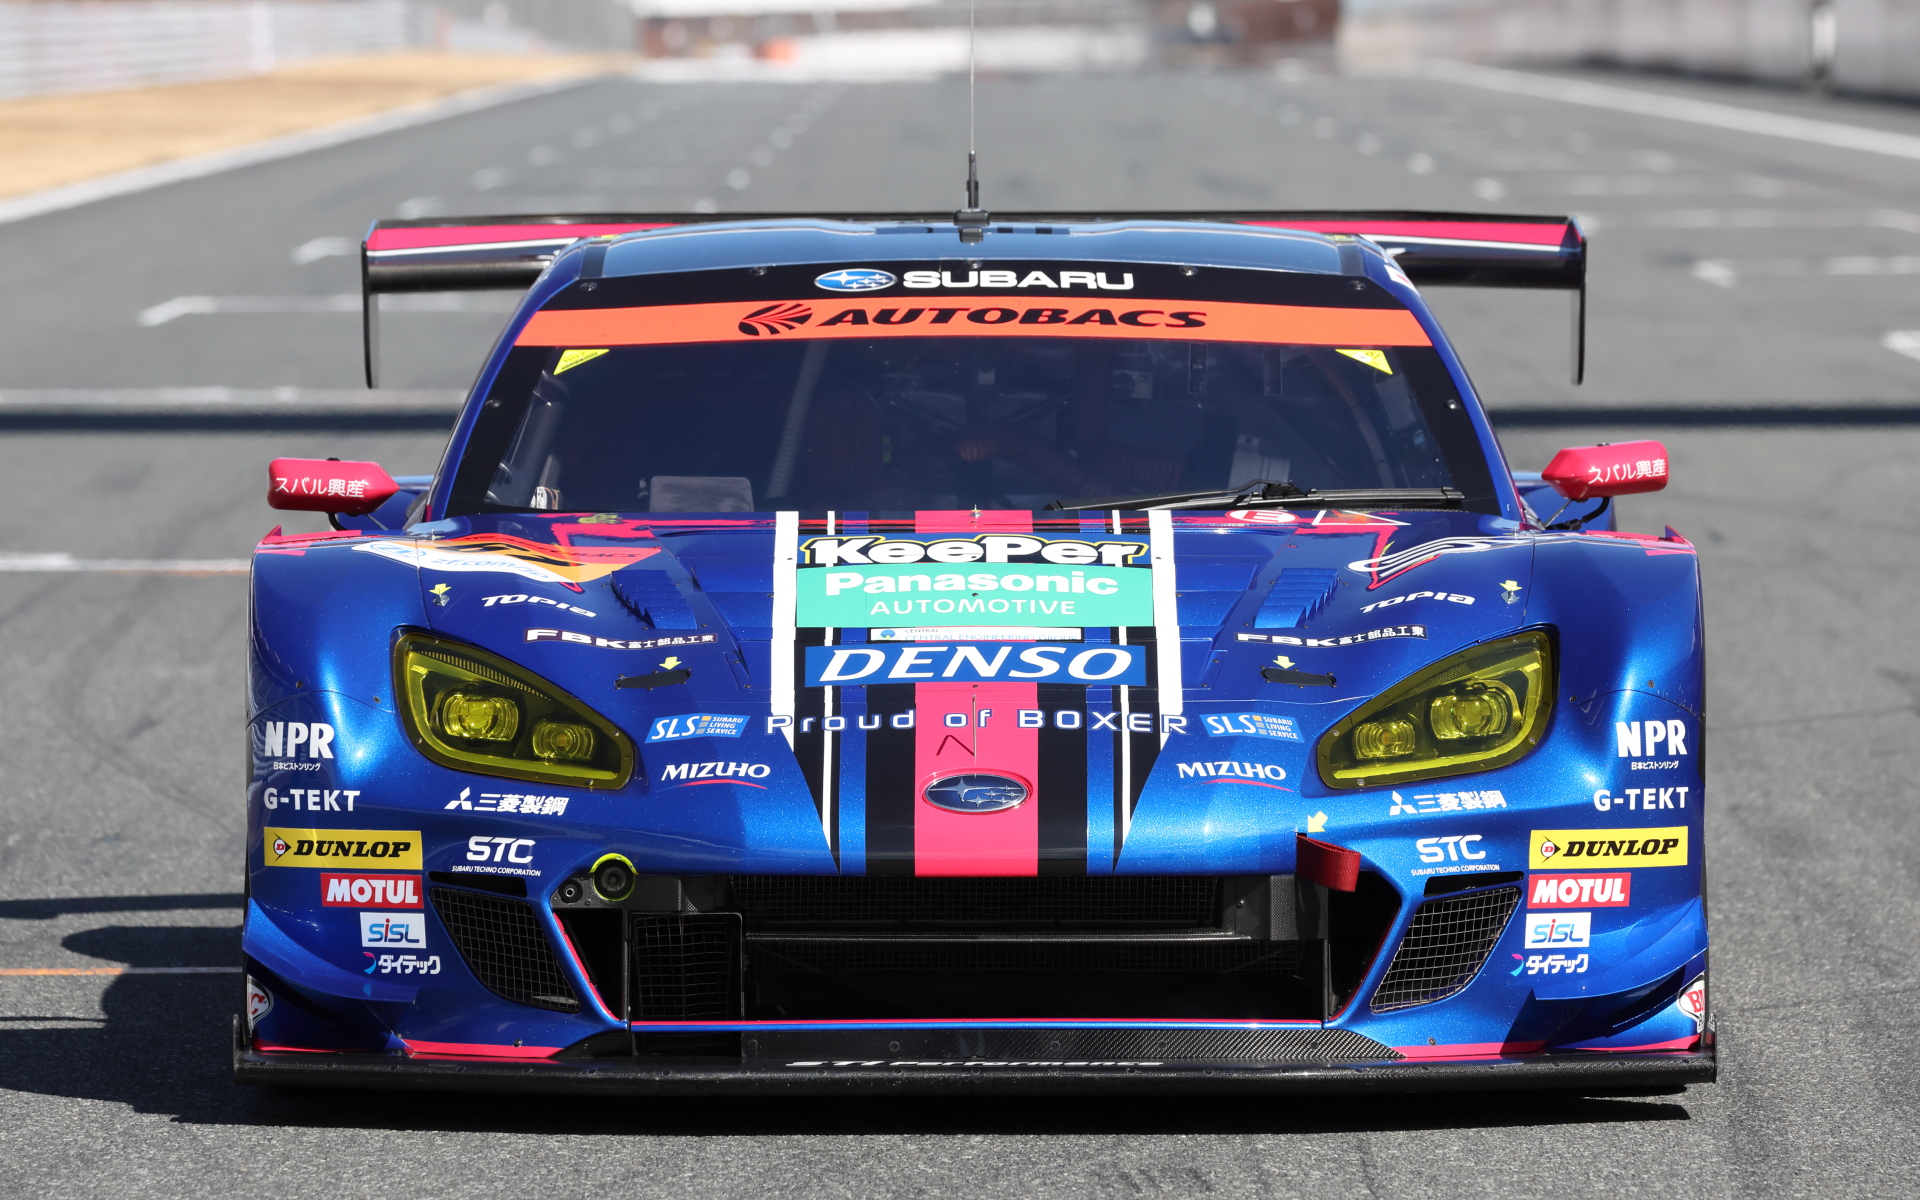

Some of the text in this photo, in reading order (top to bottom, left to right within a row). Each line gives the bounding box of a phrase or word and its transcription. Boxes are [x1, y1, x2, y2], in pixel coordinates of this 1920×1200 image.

[902, 269, 1134, 291] SUBARU
[816, 307, 1208, 328] AUTOBACS
[1588, 458, 1666, 484] スバル興産
[275, 476, 369, 498] スバル興産
[808, 536, 1146, 565] KeePer
[825, 571, 1119, 597] Panasonic
[869, 598, 1077, 616] AUTOMOTIVE
[526, 629, 715, 649] FBK 富士部品工業
[1237, 626, 1425, 647] FBK 富士部品工業
[819, 645, 1133, 682] DENSO
[651, 715, 700, 740] SLS
[766, 708, 1189, 735] Proud of BOXER
[1206, 714, 1257, 735] SLS
[1263, 716, 1293, 726] SUBARU
[1266, 722, 1292, 732] LIVING
[264, 721, 335, 759] NPR
[1269, 729, 1299, 740] SERVICE
[1616, 719, 1688, 757] NPR
[273, 762, 321, 771] 日本ピストンリング
[661, 761, 771, 781] MIZUHO
[1176, 761, 1287, 780] MIZUHO
[1631, 761, 1679, 770] 日本ピストンリング
[263, 788, 361, 812] G-TEKT
[474, 793, 569, 816] 三菱製鋼
[1413, 790, 1507, 814] 三菱製鋼
[1593, 787, 1689, 812] G-TEKT
[294, 839, 411, 858] DUNLOP
[466, 836, 536, 863] STC
[1415, 834, 1486, 863] STC
[1562, 838, 1679, 857] DUNLOP
[452, 865, 541, 876] SUBARU TECHNO CORPORATION
[1411, 864, 1500, 876] SUBARU TECHNO CORPORATION
[326, 878, 419, 904] MOTUL
[1532, 878, 1625, 904] MOTUL
[378, 954, 441, 975] ダイテック
[1525, 953, 1589, 975] ダイテック
